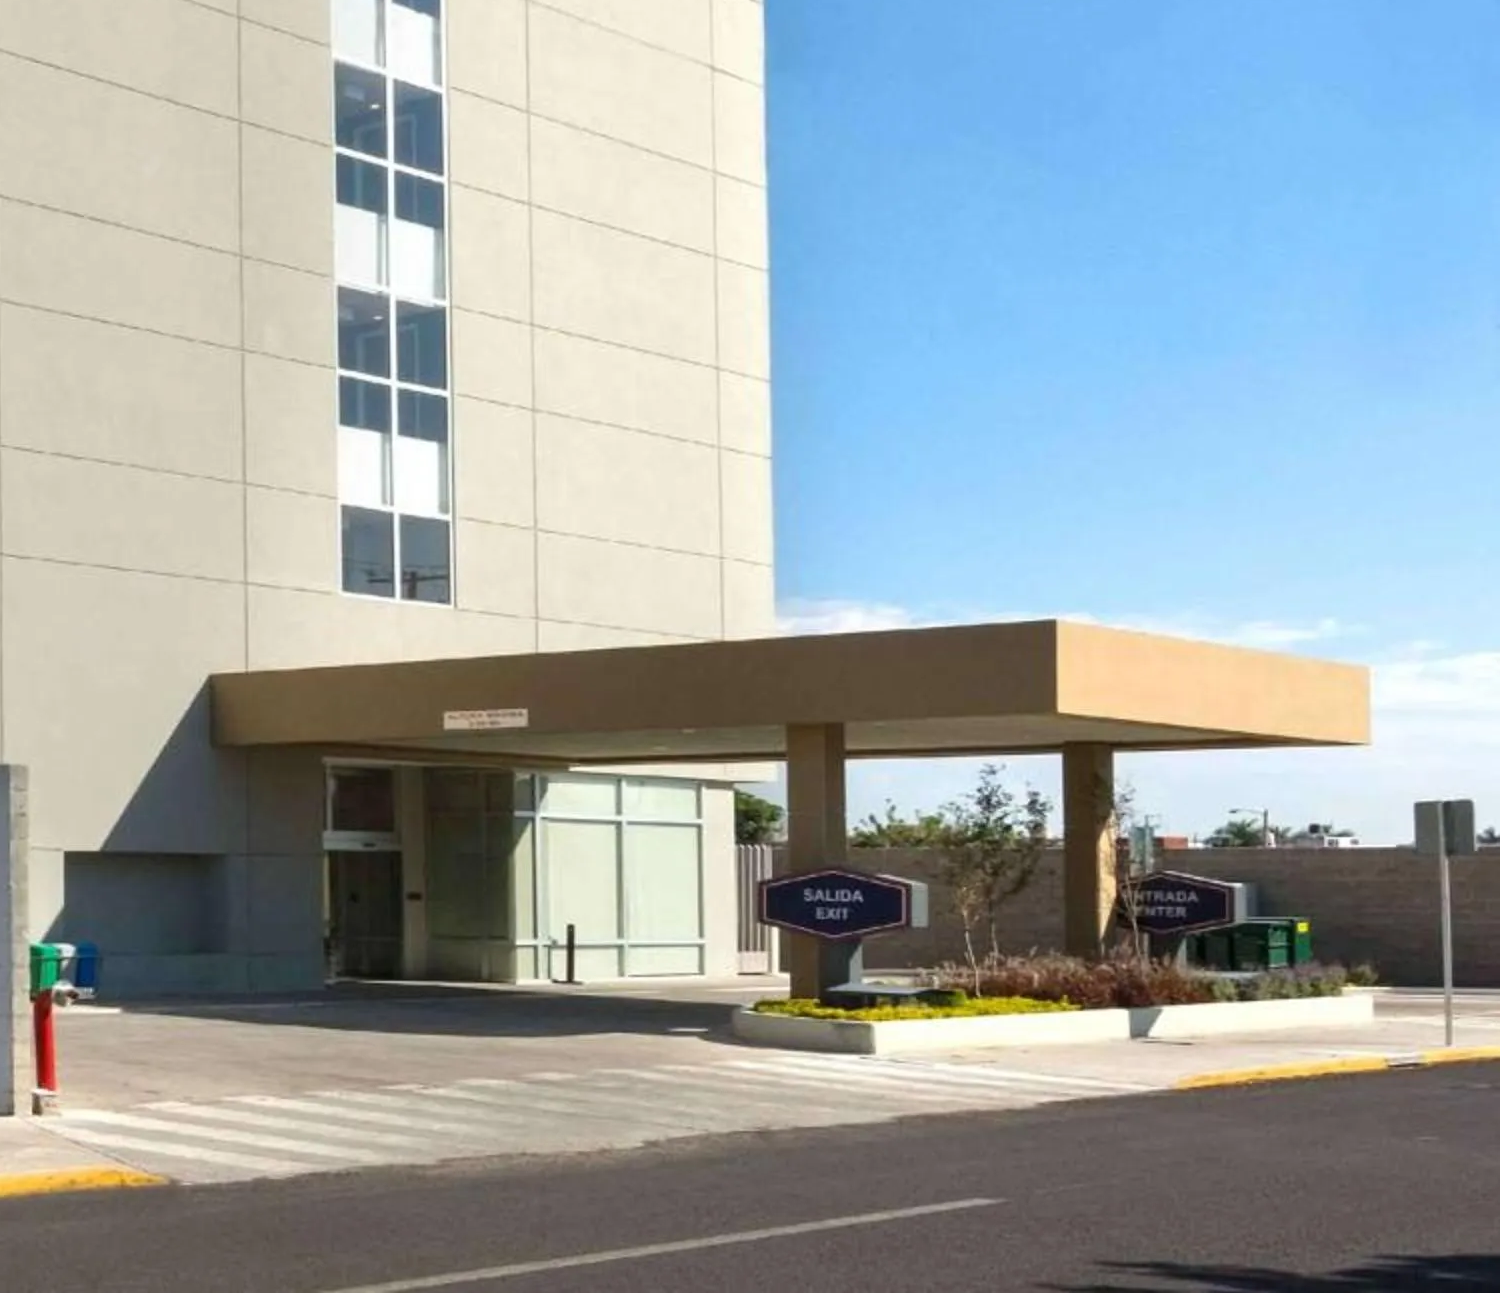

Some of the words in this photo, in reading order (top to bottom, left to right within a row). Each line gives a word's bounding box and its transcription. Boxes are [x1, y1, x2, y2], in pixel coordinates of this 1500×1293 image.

[803, 888, 864, 903] SALIDA
[1125, 889, 1199, 903] NTRADA
[815, 907, 849, 920] EXIT
